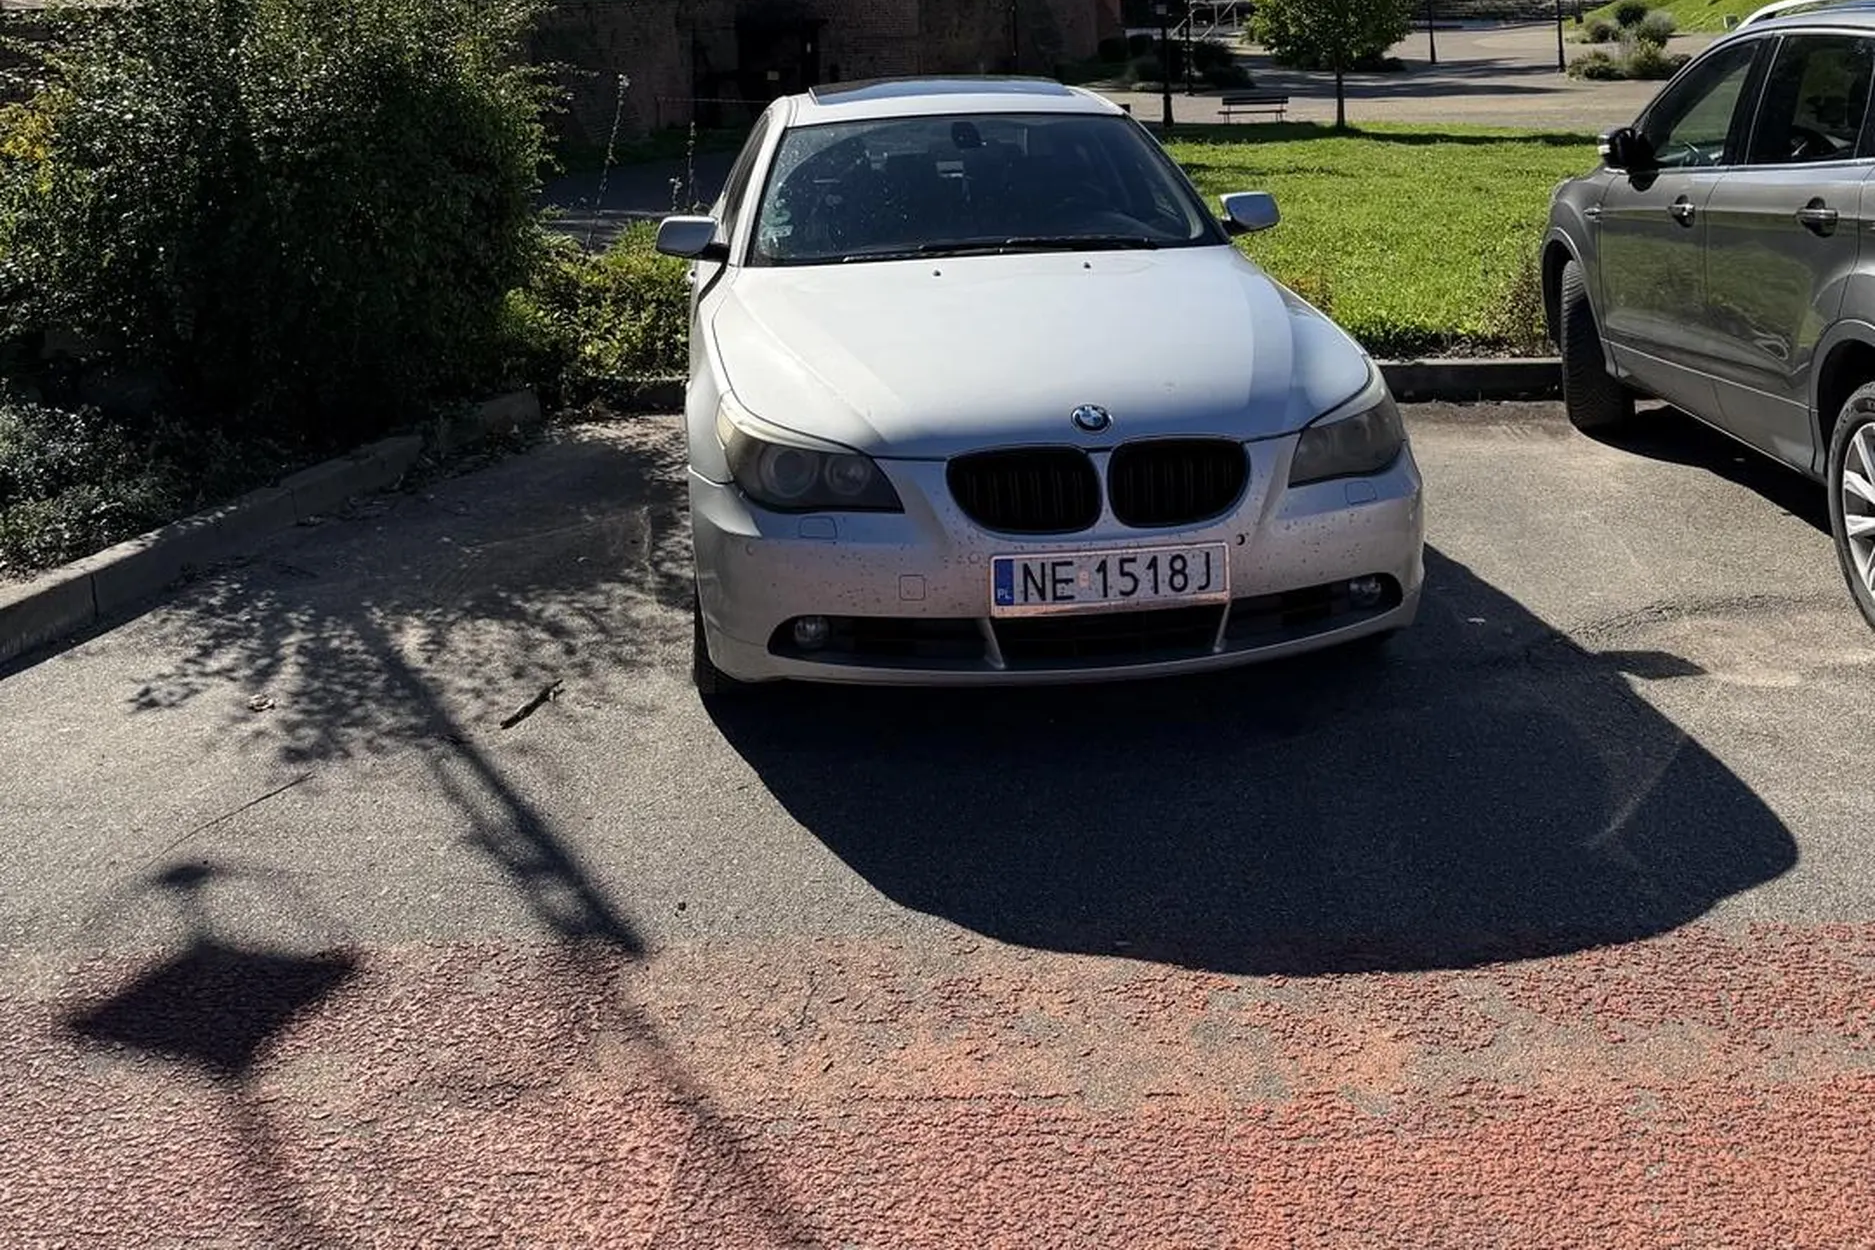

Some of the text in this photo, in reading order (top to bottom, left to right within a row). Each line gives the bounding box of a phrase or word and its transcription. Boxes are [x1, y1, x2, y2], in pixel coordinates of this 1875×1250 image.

[1022, 551, 1211, 602] NE 1518J
[997, 589, 1011, 600] PL
